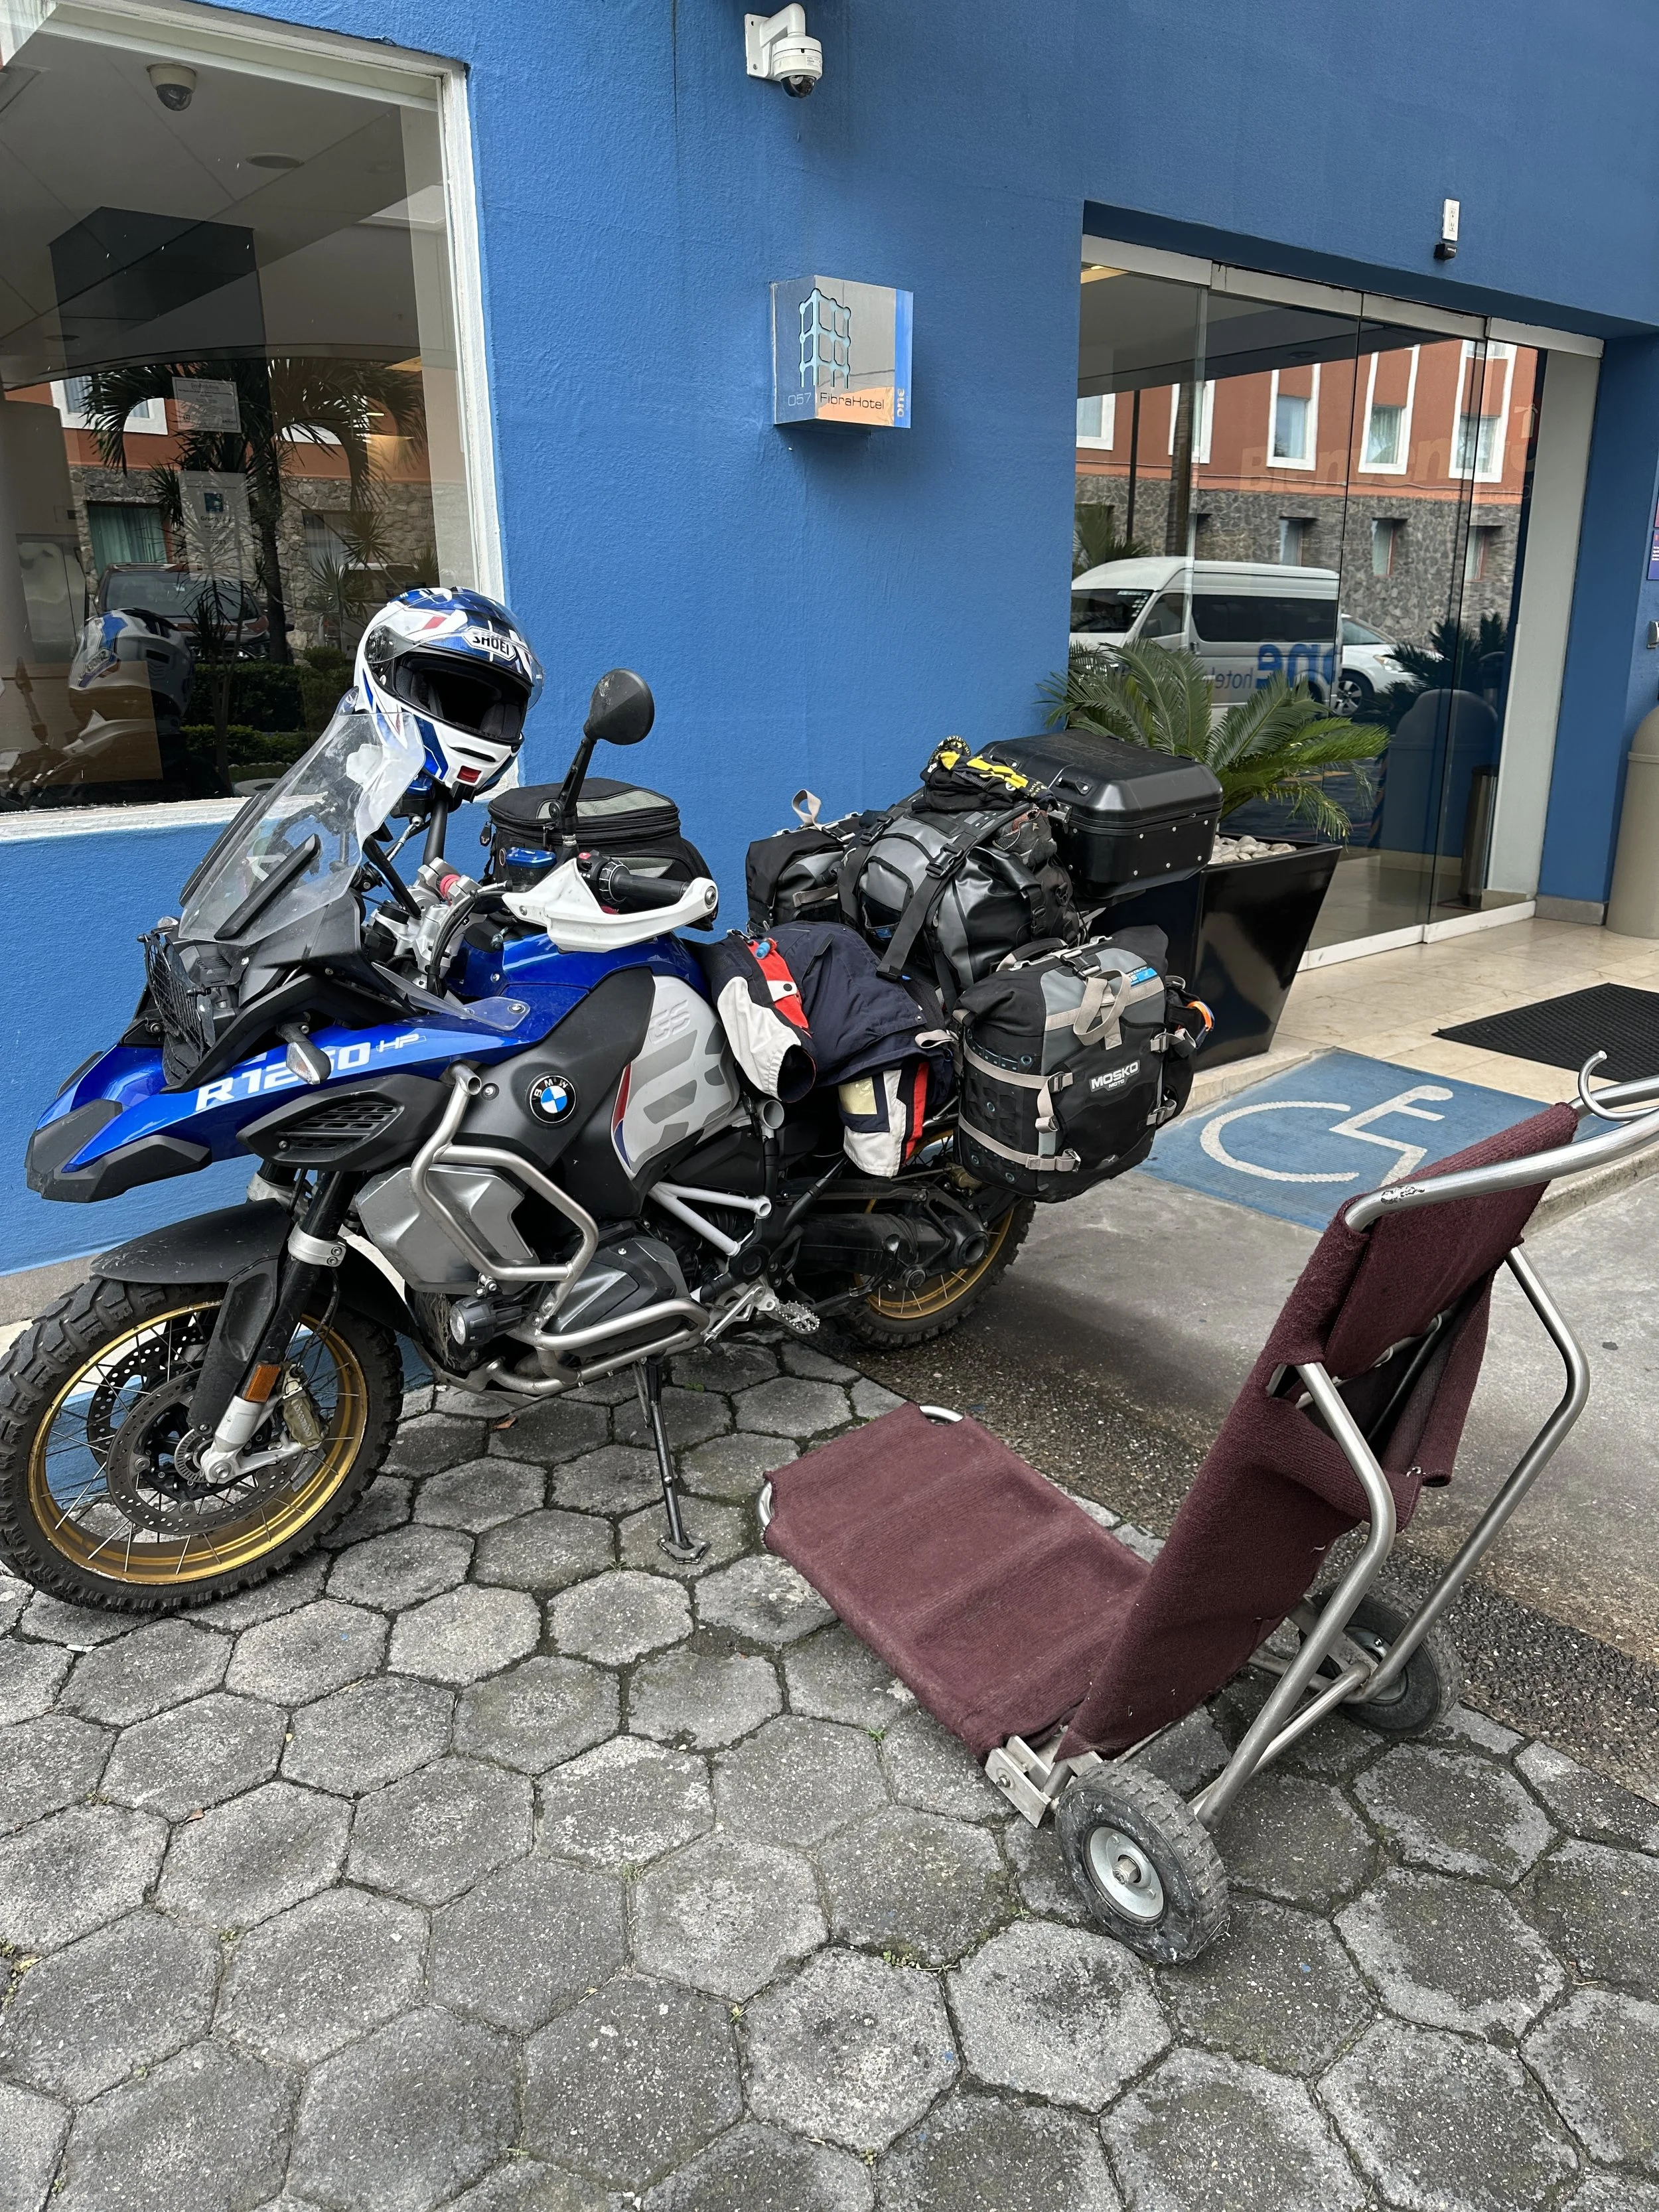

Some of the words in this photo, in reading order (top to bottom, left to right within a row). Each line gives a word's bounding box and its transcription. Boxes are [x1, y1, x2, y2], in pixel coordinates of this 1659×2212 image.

[788, 392, 812, 406] 057
[820, 392, 885, 409] FibraHotel
[472, 635, 510, 656] SHOEI
[648, 999, 691, 1045] GS
[241, 1042, 371, 1094] 120
[376, 1033, 427, 1053] HP
[1091, 1061, 1138, 1089] MOSKO
[533, 1078, 569, 1098] BMW
[1108, 1078, 1125, 1088] MOTO
[293, 1402, 313, 1438] brembo
